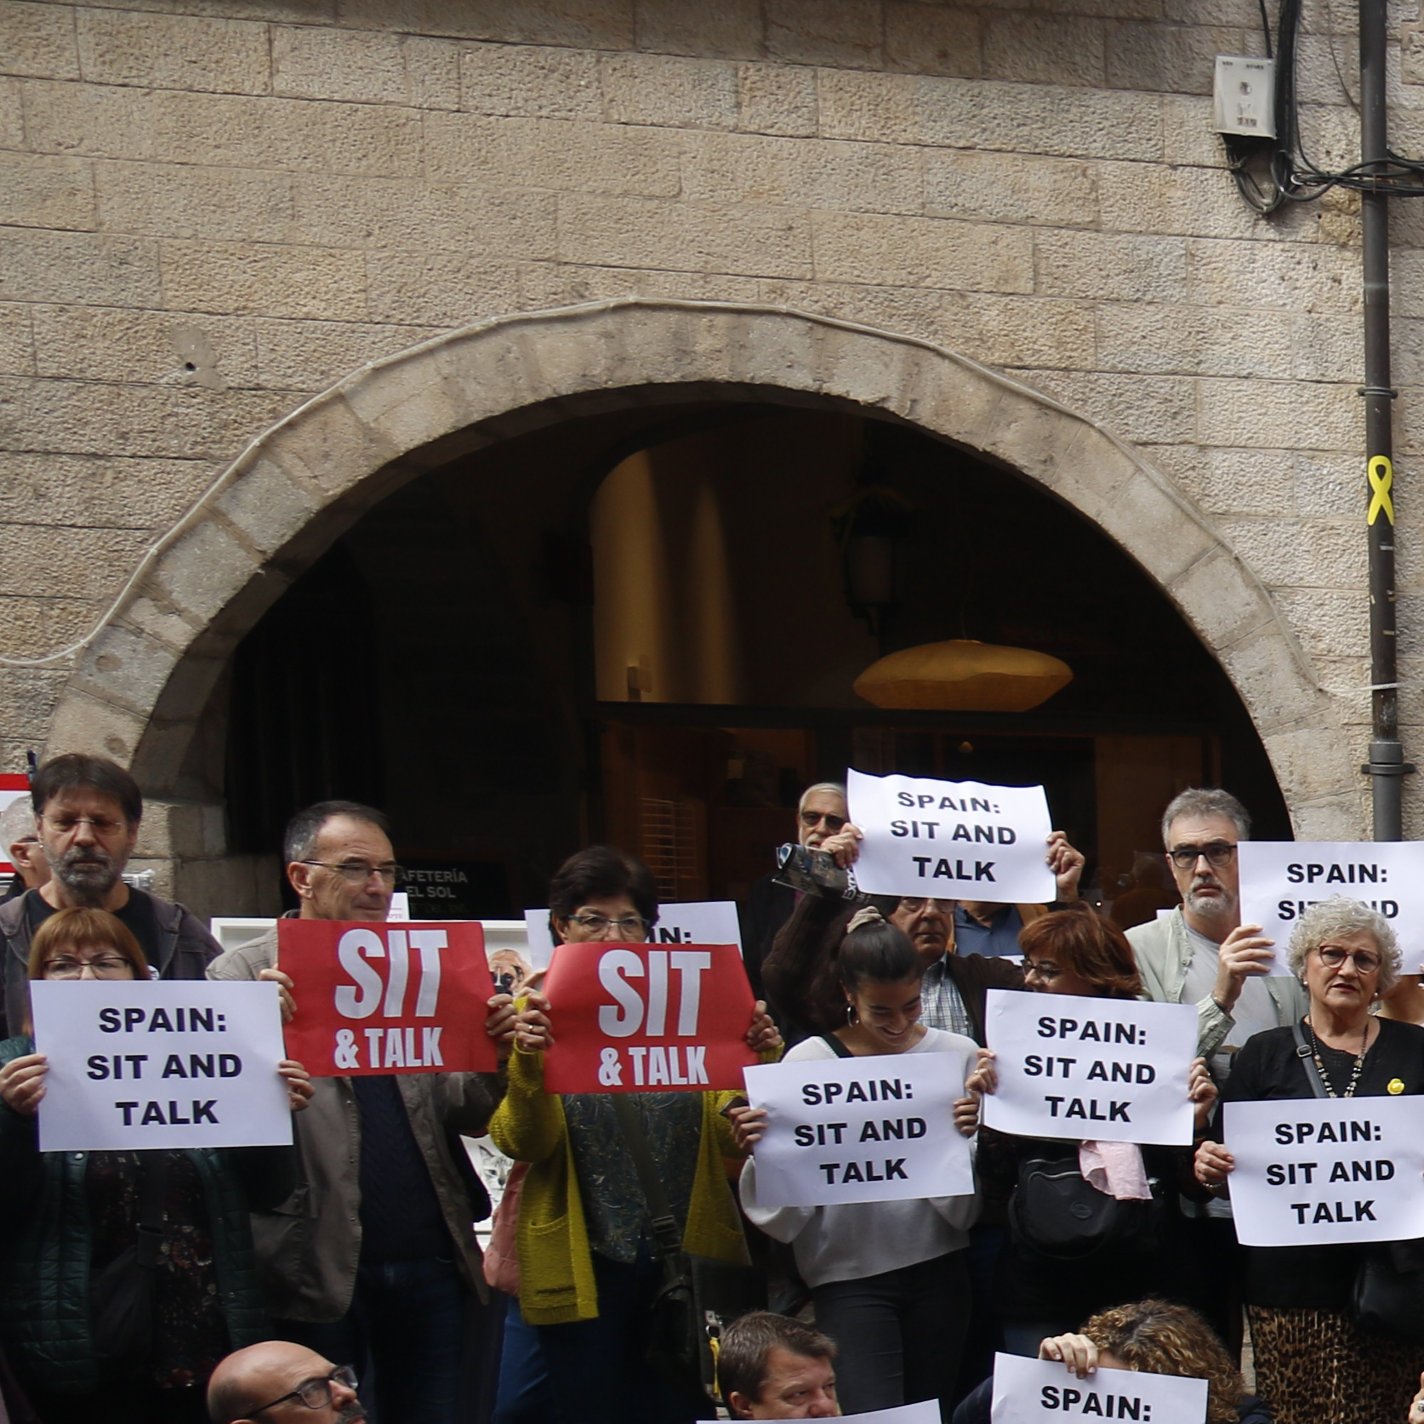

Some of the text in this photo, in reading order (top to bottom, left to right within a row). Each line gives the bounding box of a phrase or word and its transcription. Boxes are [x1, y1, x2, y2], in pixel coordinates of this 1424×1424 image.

[898, 792, 1000, 813] SPAIN:
[891, 821, 1016, 845] SIT AND
[399, 867, 468, 883] AFETERÍA
[912, 857, 995, 882] TALK
[1287, 864, 1386, 883] SPAIN:
[407, 886, 456, 898] EL SOL
[335, 929, 448, 1018] SIT
[599, 950, 710, 1037] SIT
[99, 1008, 226, 1033] SPAIN:
[1038, 1017, 1145, 1045] SPAIN:
[335, 1028, 443, 1069] & TALK
[87, 1054, 242, 1080] SIT AND
[599, 1046, 709, 1086] & TALK
[1024, 1055, 1155, 1084] SIT AND
[802, 1079, 912, 1105] SPAIN:
[115, 1100, 219, 1126] TALK
[1045, 1096, 1131, 1122] TALK
[794, 1118, 926, 1146] SIT AND
[1275, 1121, 1381, 1145] SPAIN:
[819, 1158, 908, 1184] TALK
[1267, 1160, 1394, 1185] SIT AND
[1291, 1201, 1376, 1224] TALK
[1041, 1386, 1151, 1421] SPAIN:
